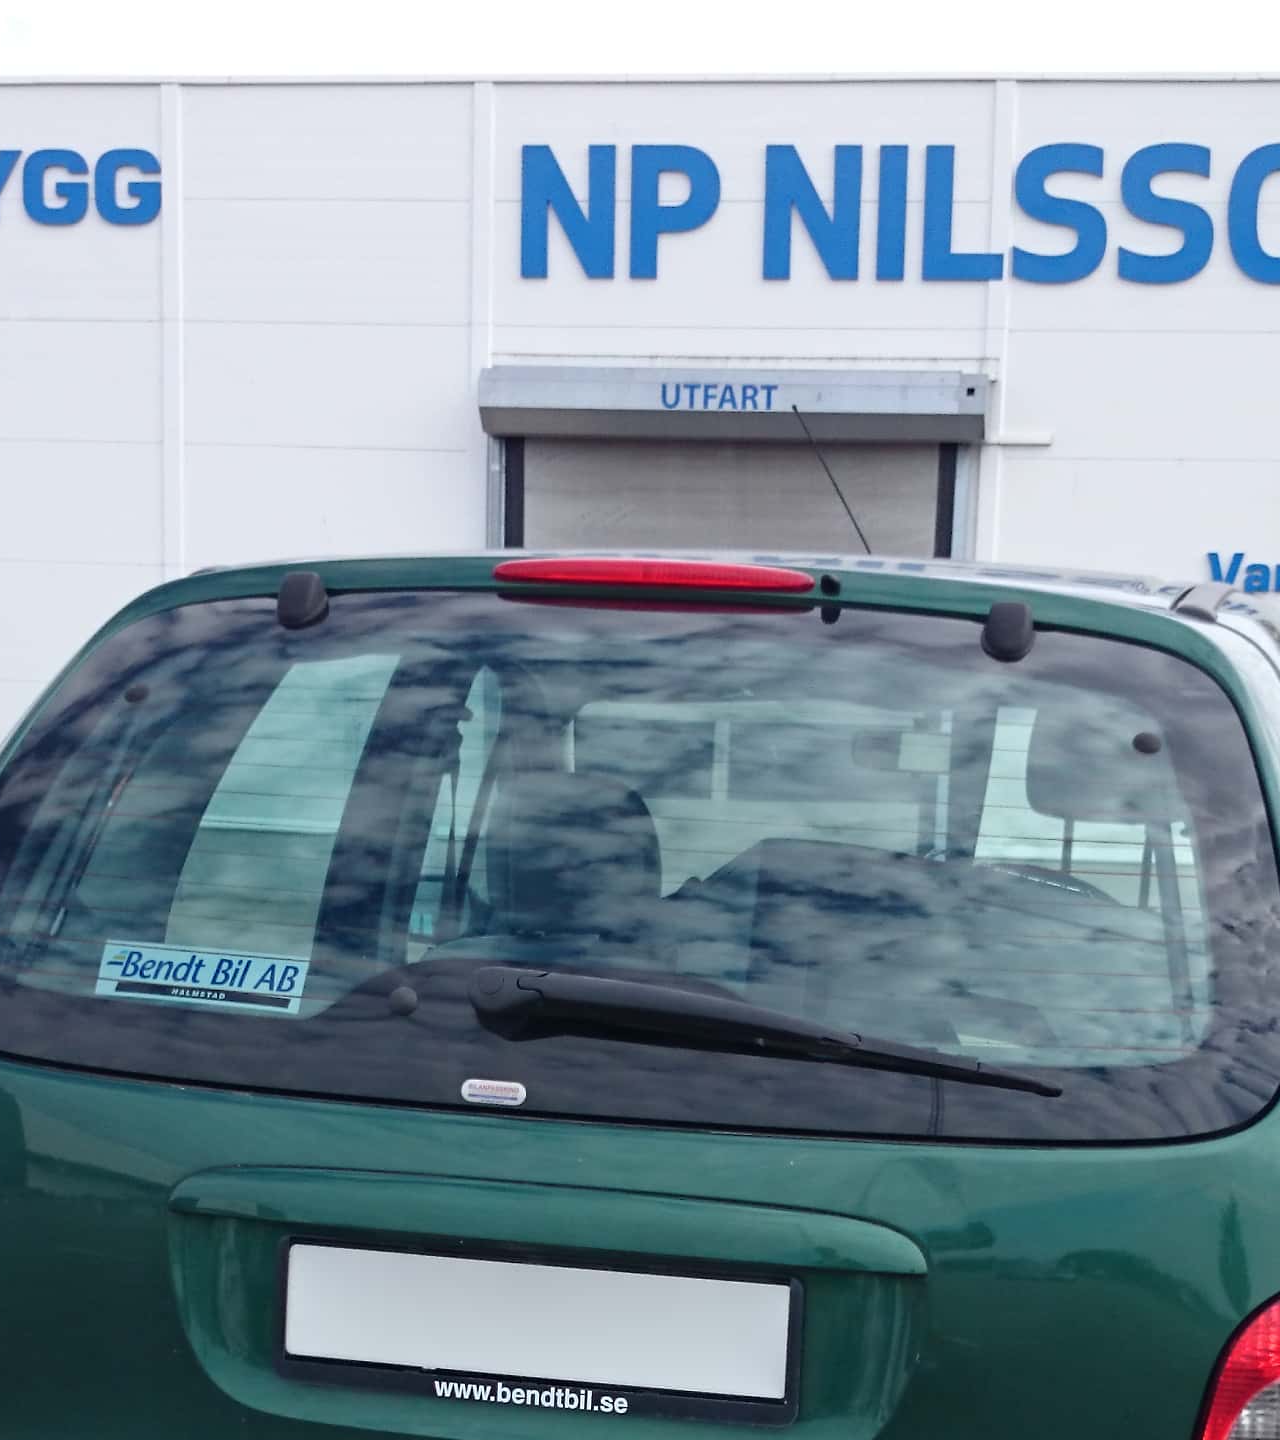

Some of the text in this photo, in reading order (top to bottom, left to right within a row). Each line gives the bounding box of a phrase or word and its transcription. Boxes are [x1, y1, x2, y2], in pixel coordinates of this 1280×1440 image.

[520, 144, 721, 280] NP
[660, 383, 779, 412] UTFART
[121, 950, 300, 993] Bendt Bil AB
[171, 988, 226, 1000] HALMSTAD
[434, 1380, 629, 1414] www.bendtbil.se
